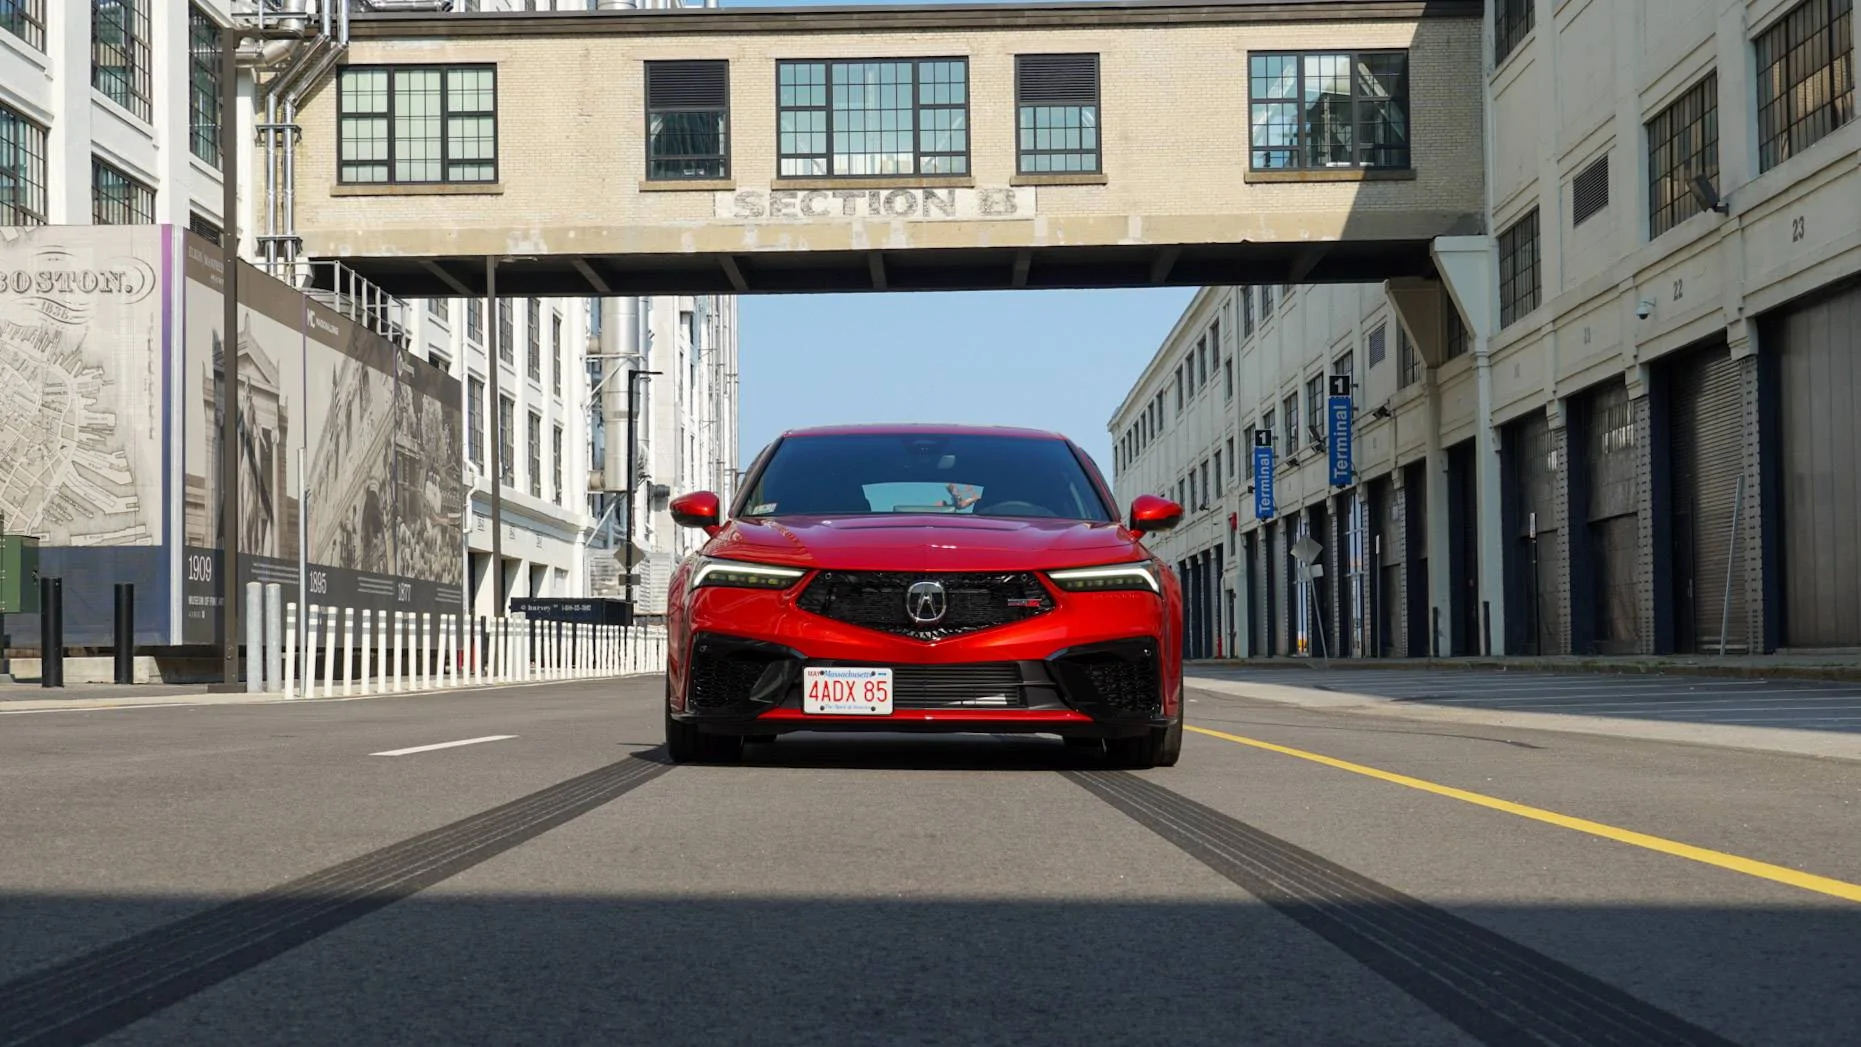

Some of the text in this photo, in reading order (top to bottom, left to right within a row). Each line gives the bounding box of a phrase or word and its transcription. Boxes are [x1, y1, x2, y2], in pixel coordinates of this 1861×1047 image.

[733, 187, 1019, 218] SECTION B
[1791, 215, 1805, 243] 23
[1672, 278, 1684, 302] 22
[1334, 377, 1344, 394] 1
[1258, 431, 1267, 446] 1
[1334, 405, 1348, 478] Terminal
[1258, 453, 1270, 512] Terminal
[188, 555, 212, 582] 1909
[309, 570, 327, 594] 1895
[809, 680, 887, 702] 4ADX 85
